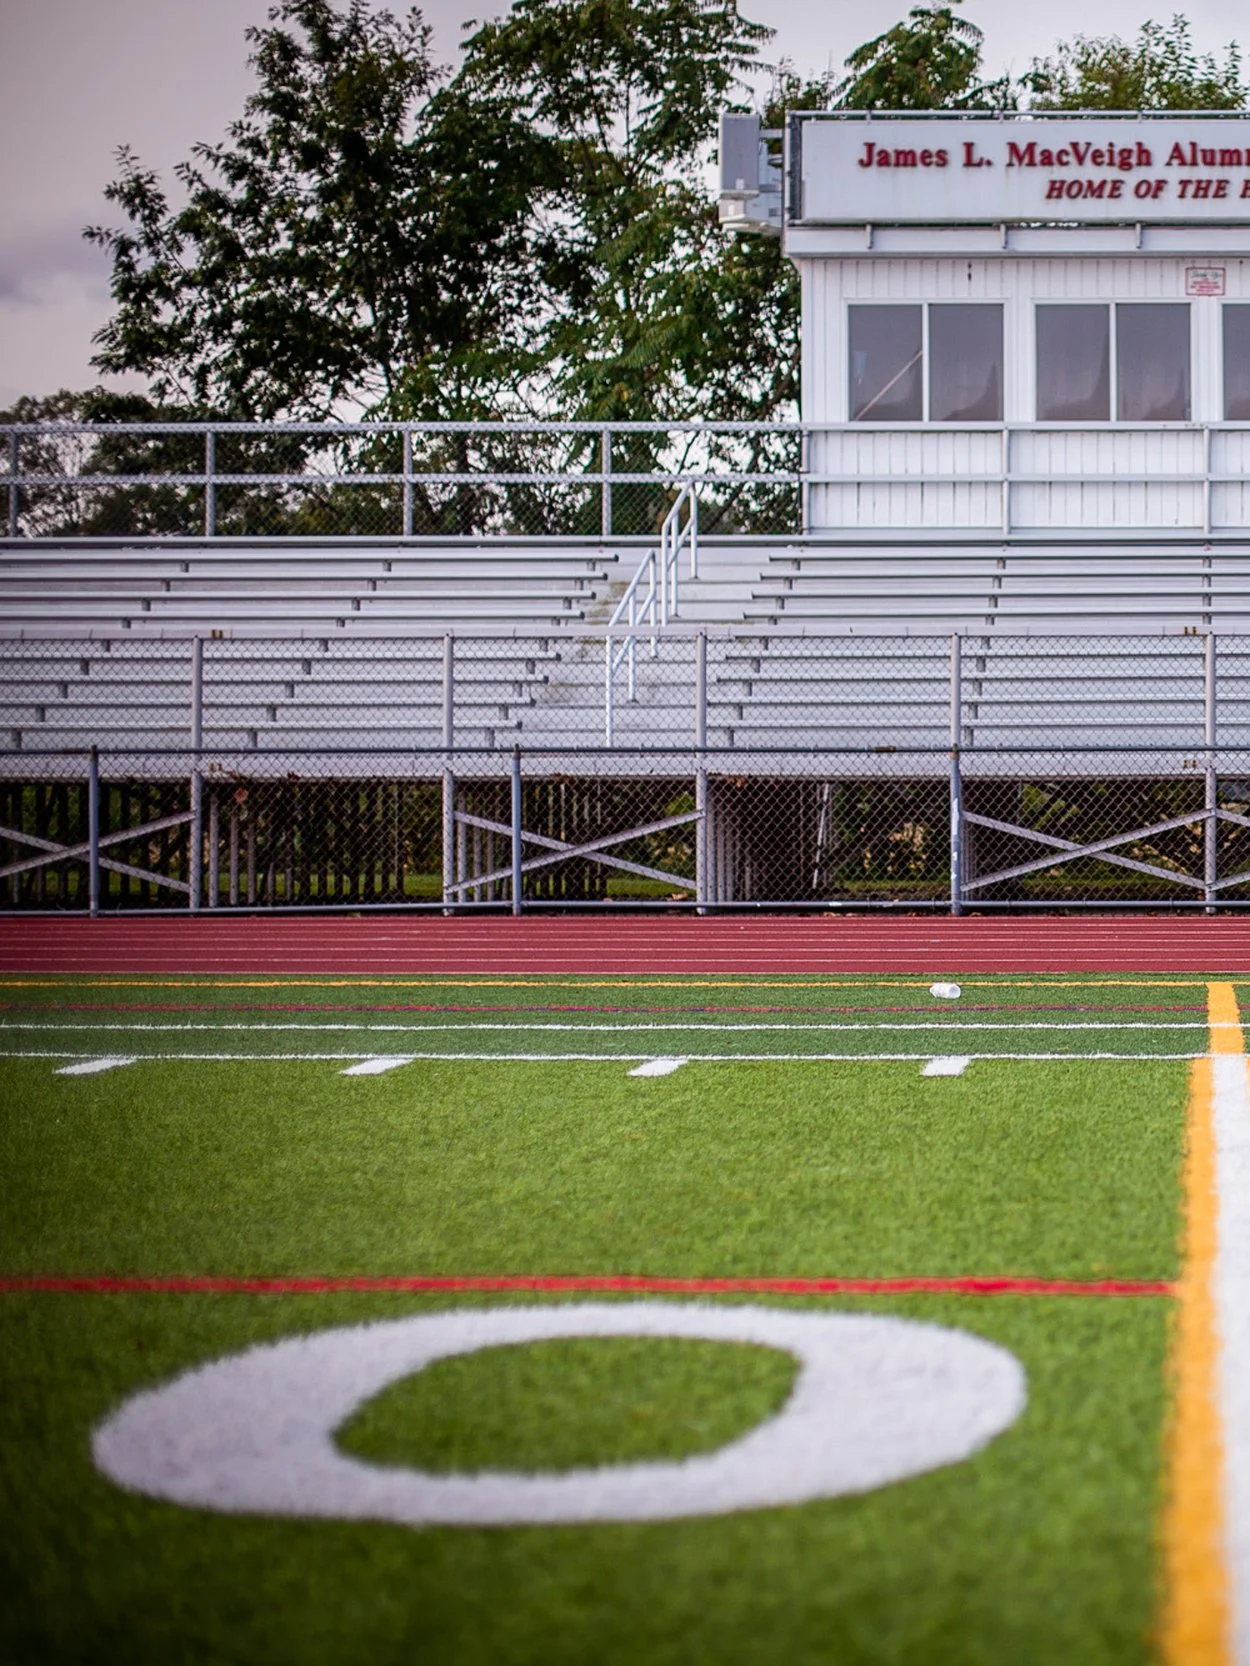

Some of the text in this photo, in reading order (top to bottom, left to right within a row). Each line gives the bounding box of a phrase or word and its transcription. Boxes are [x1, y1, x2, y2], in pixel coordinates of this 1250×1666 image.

[859, 142, 948, 168] James
[963, 142, 992, 167] L.
[1006, 141, 1152, 171] MacVeigh
[1046, 179, 1123, 200] HOME
[1134, 179, 1168, 199] OF
[1178, 179, 1230, 199] THE
